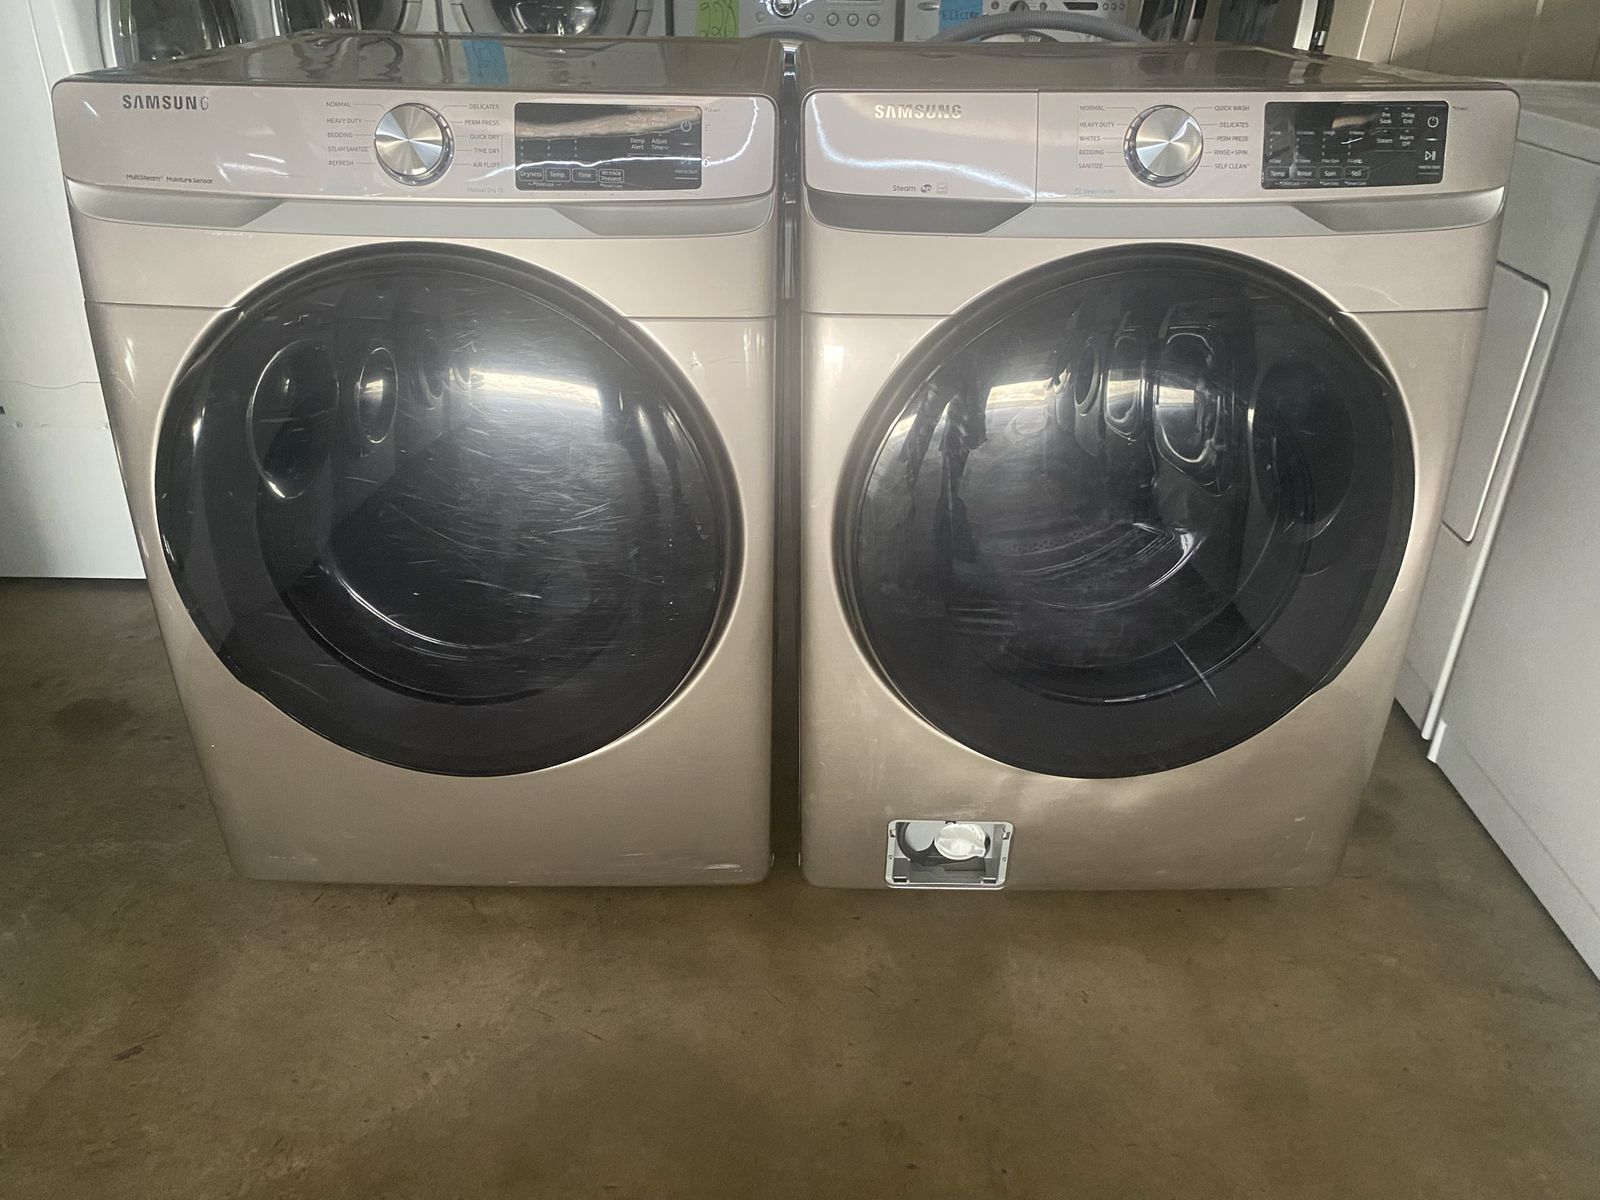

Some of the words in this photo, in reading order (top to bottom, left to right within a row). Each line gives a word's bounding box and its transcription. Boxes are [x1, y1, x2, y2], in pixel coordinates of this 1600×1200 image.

[874, 103, 962, 119] SAMSUNG
[630, 137, 645, 145] Damp
[651, 137, 668, 145] Adjust
[519, 170, 542, 179] Dryness
[1324, 169, 1337, 178] Spin
[166, 176, 193, 184] Moisture
[193, 177, 214, 185] Sensor
[892, 184, 916, 192] Steam
